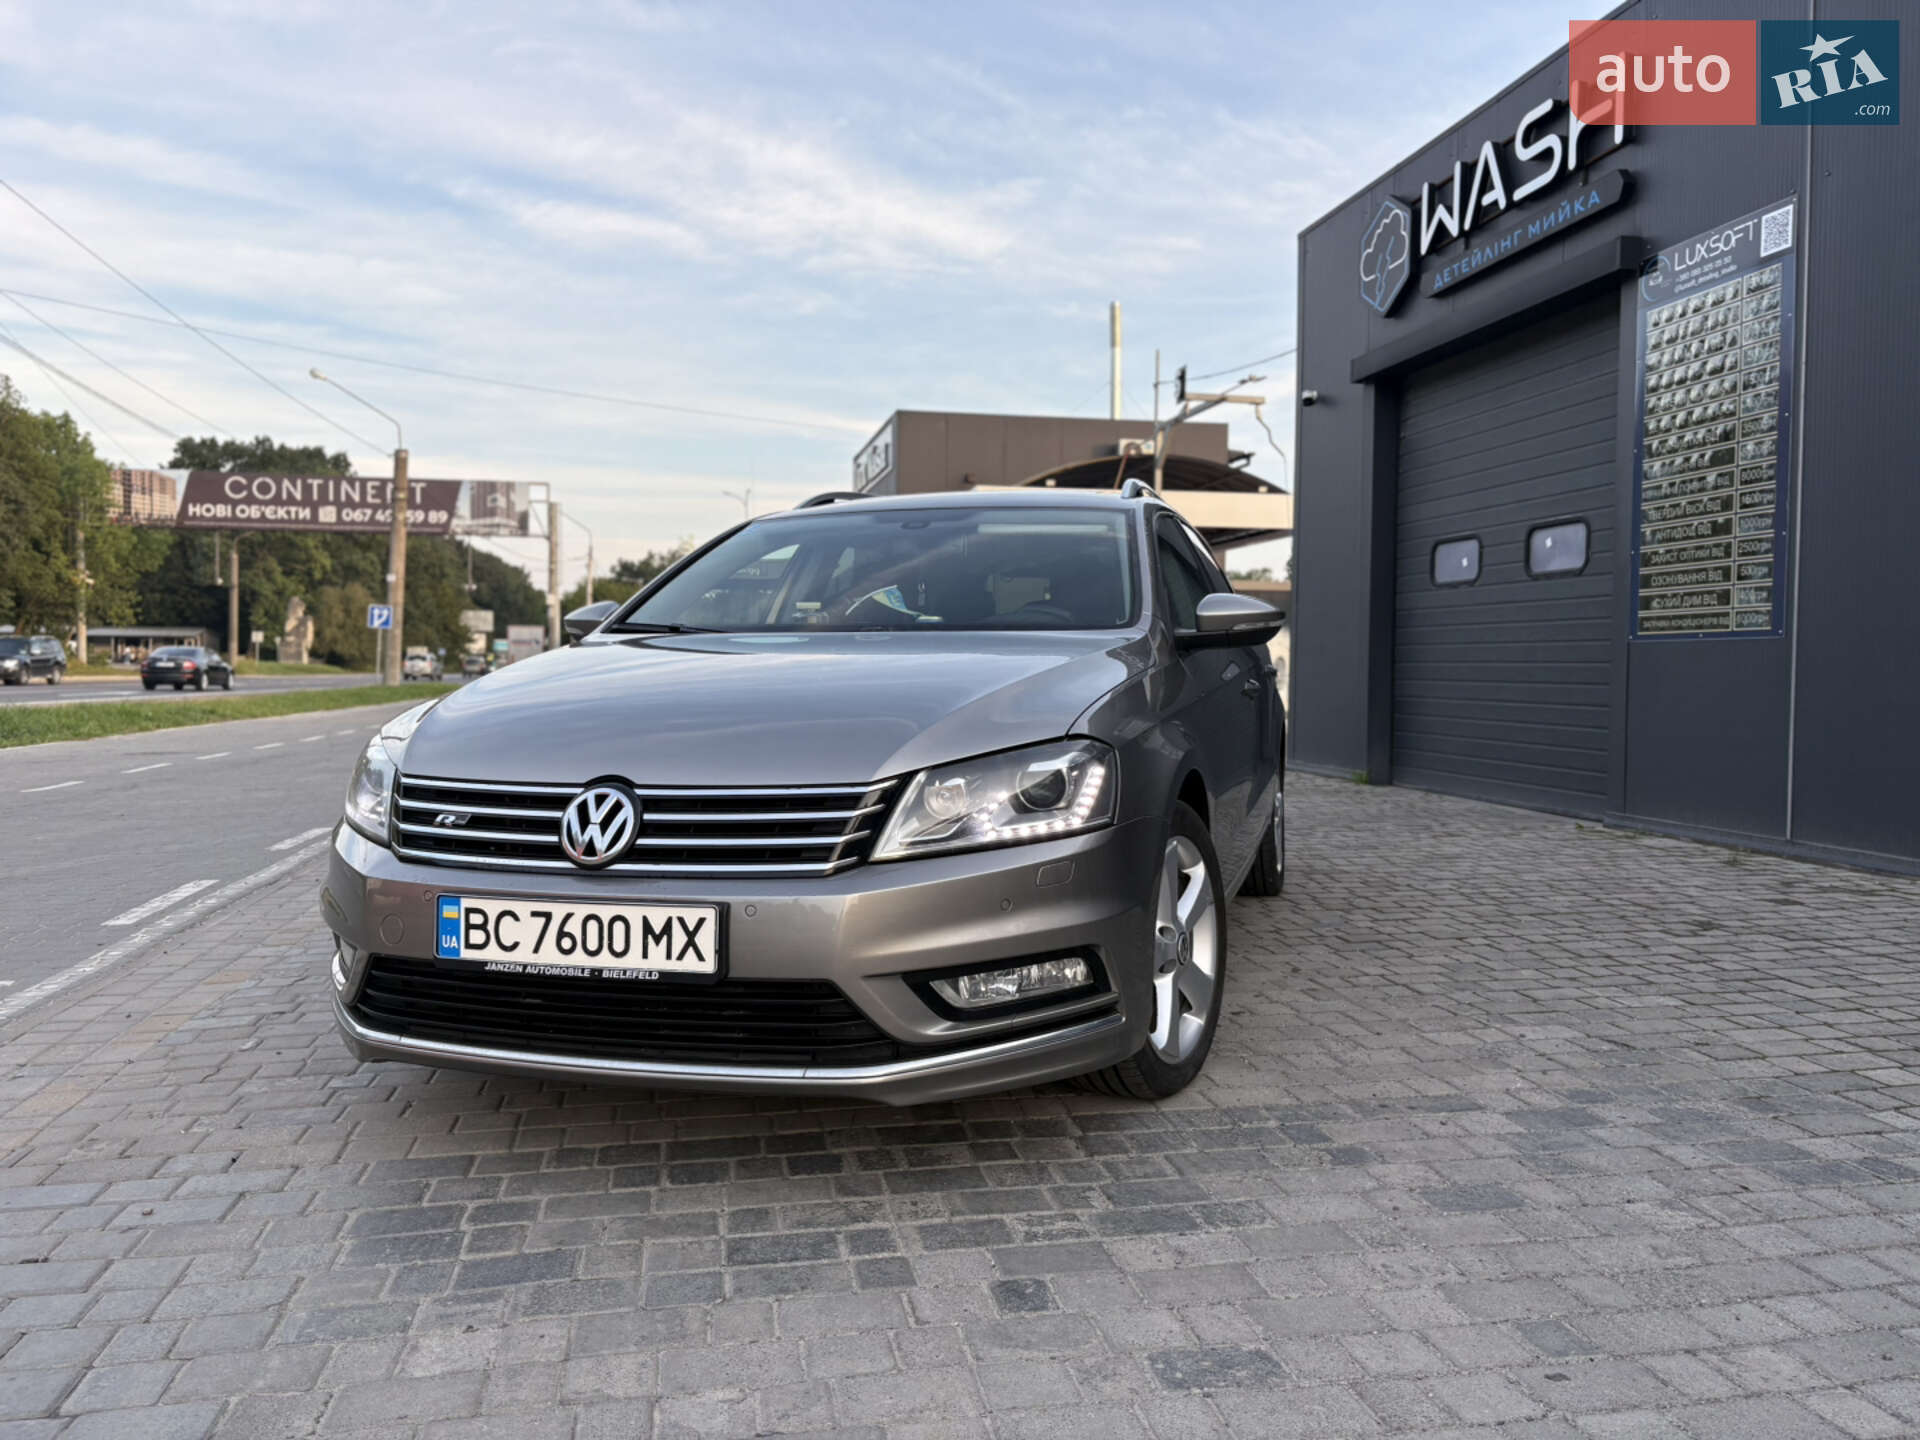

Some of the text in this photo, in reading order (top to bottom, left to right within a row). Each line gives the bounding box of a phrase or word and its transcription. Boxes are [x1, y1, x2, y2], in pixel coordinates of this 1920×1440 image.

[1420, 51, 1625, 257] WASH
[1432, 190, 1601, 290] ДЕТЕЙЛІНГ МИЙКА
[1674, 218, 1758, 272] LUXSOFT
[187, 503, 232, 518] НОВІ
[235, 504, 311, 520] ОБ'ЄКТИ
[342, 510, 372, 522] 067
[406, 509, 425, 524] 59
[427, 509, 449, 525] 89
[442, 935, 459, 949] UA
[464, 907, 707, 963] BC 7600 MX
[484, 961, 660, 980] JANZEN AUTOMOBILE BIELEFELD
